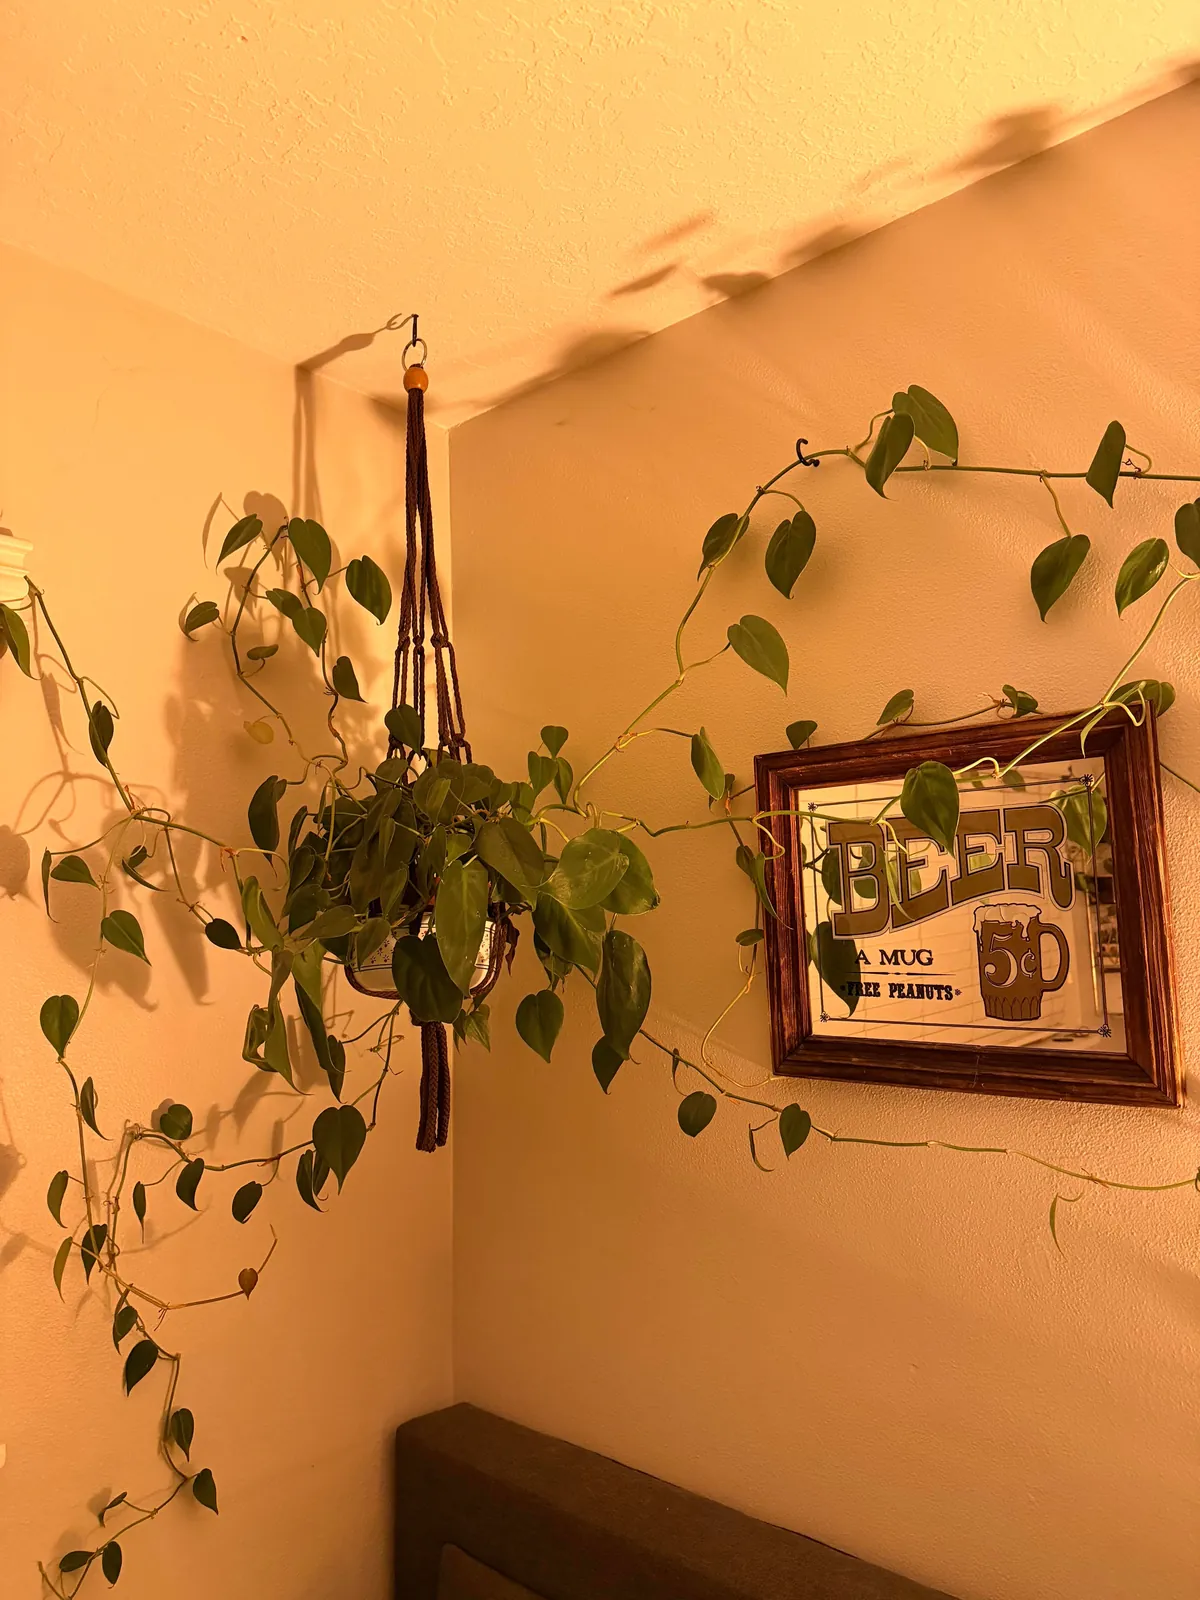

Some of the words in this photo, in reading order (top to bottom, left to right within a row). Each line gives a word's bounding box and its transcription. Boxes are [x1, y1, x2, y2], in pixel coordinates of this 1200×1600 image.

[826, 804, 1075, 939] BEER
[855, 949, 871, 965] A
[879, 949, 934, 966] MUG
[984, 932, 1037, 988] 5¢
[847, 981, 881, 997] FREE
[888, 983, 953, 1000] PEANUTS
